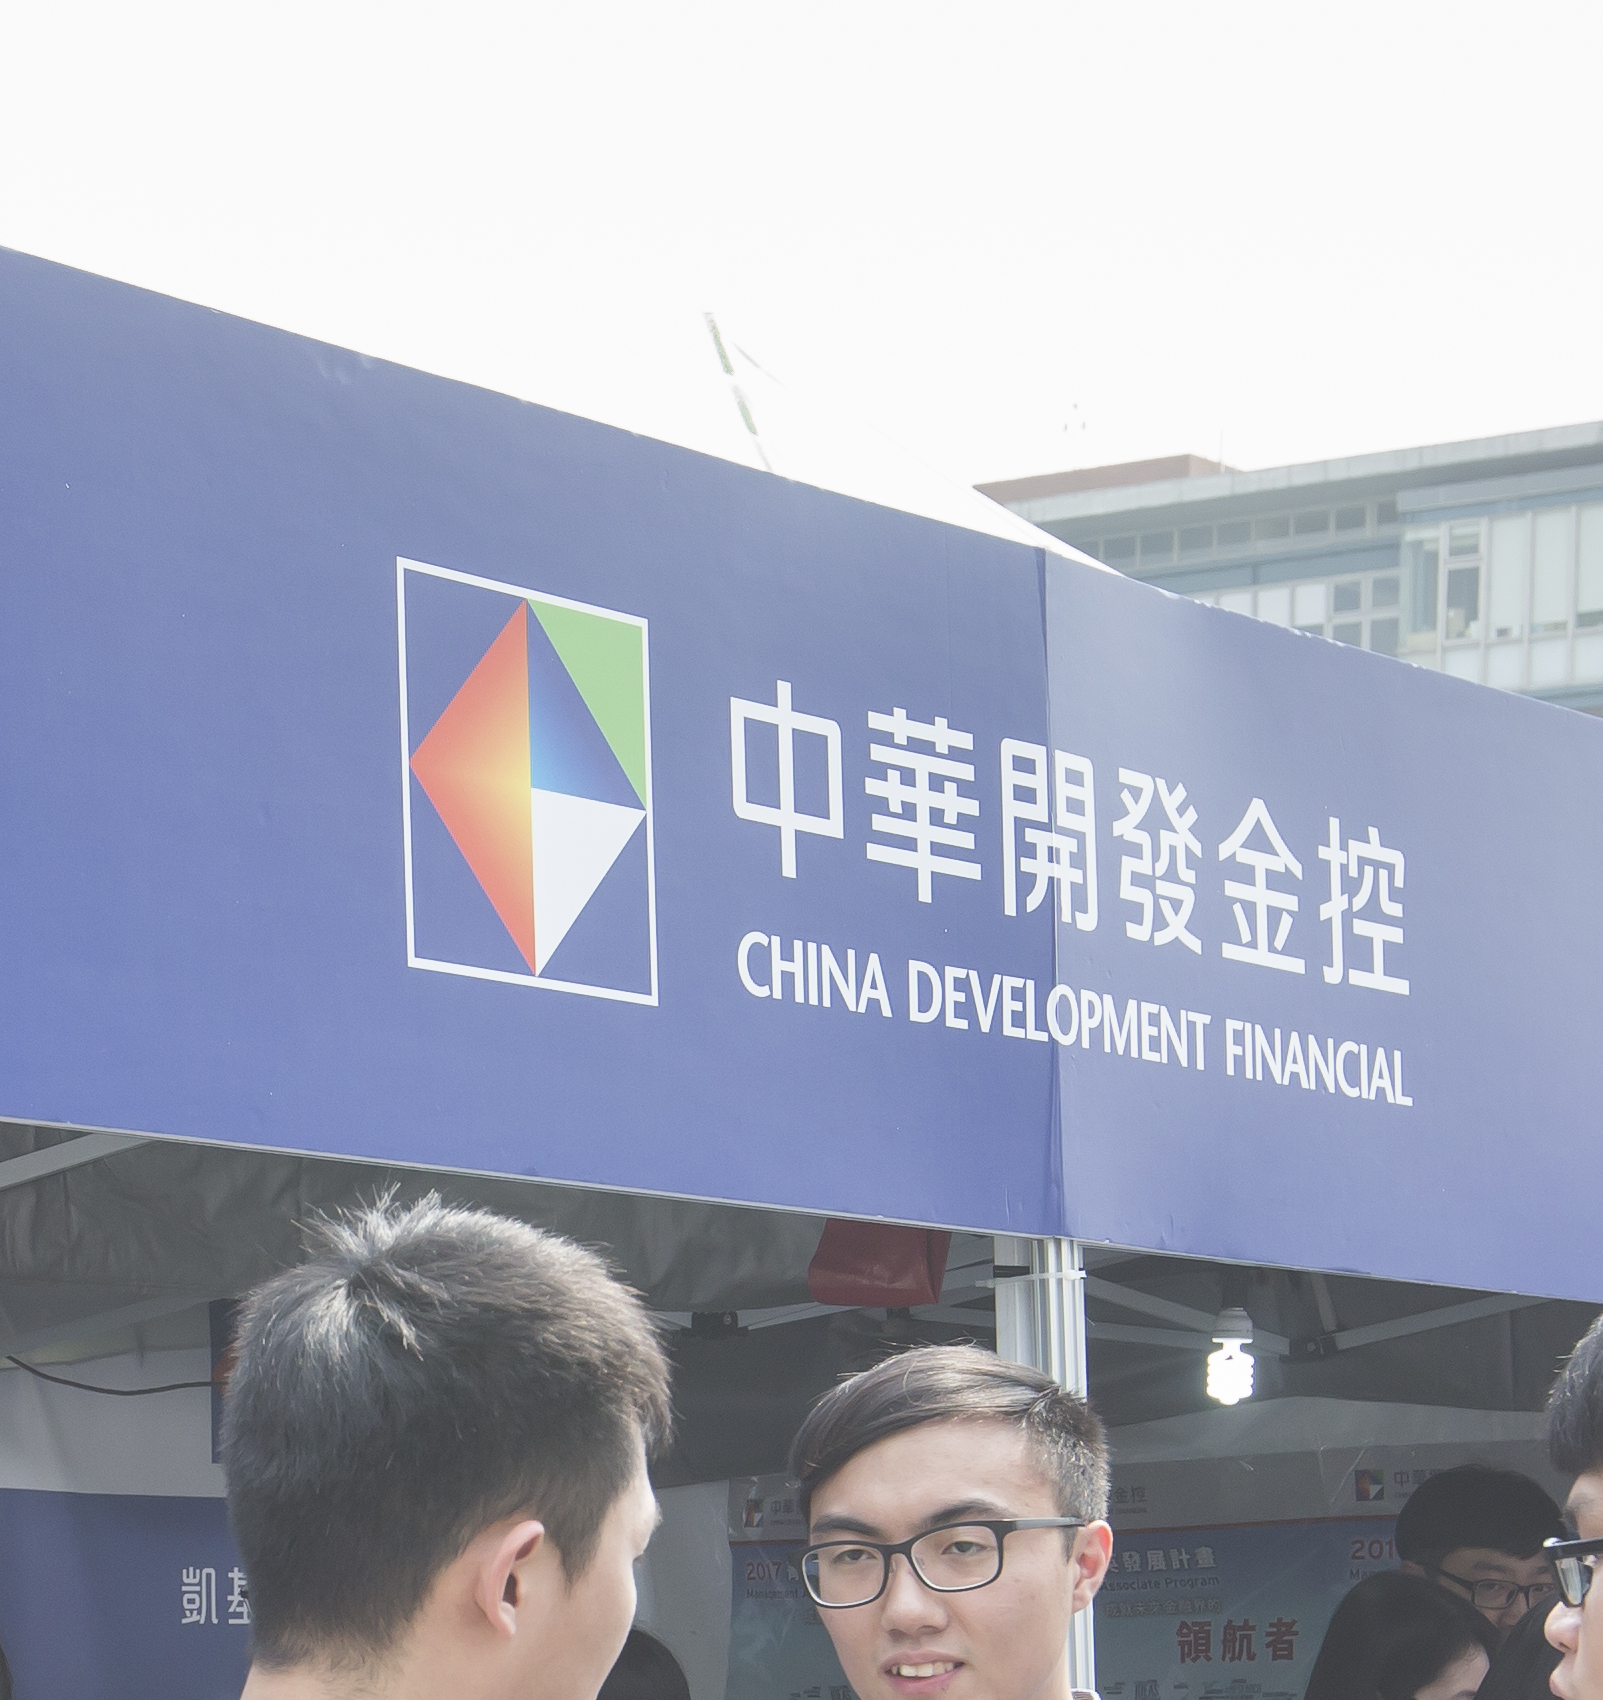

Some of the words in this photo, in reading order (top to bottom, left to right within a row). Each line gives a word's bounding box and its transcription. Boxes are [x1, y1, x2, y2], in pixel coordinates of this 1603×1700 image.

[729, 680, 1412, 997] 中華開發金控
[737, 929, 893, 1019] CHINA
[907, 959, 1212, 1071] DEVELOPMENT
[1224, 1017, 1414, 1108] FINANCIAL
[746, 1561, 783, 1581] 2017
[1101, 1577, 1161, 1593] Associate
[1164, 1575, 1220, 1592] Program
[1176, 1617, 1299, 1664] 領航者
